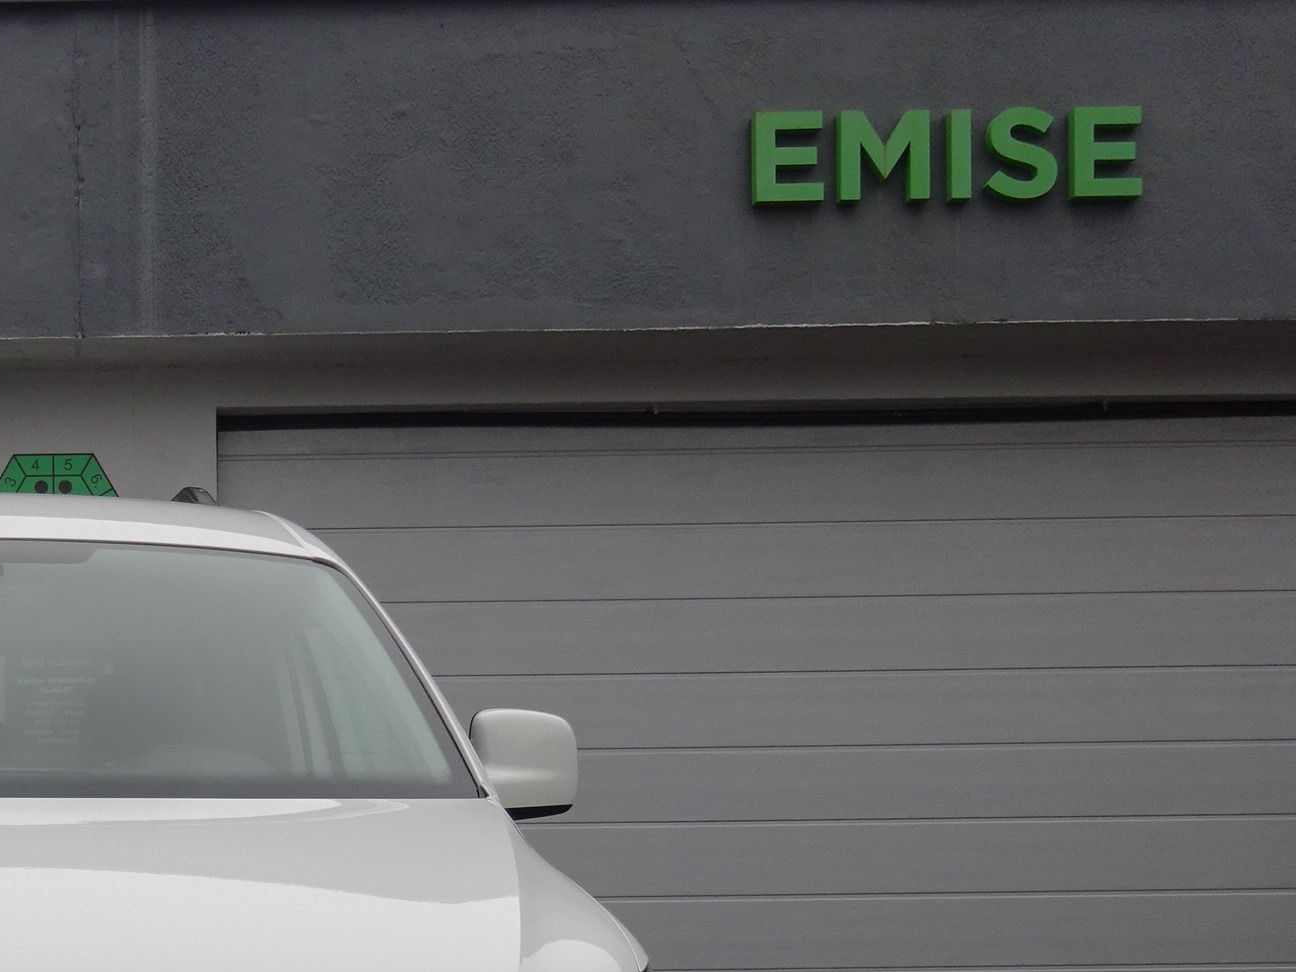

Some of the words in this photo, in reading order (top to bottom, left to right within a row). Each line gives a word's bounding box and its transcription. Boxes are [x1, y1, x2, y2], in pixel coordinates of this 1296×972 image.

[750, 106, 1142, 206] EMISE
[31, 459, 40, 471] 4
[64, 459, 73, 471] 5
